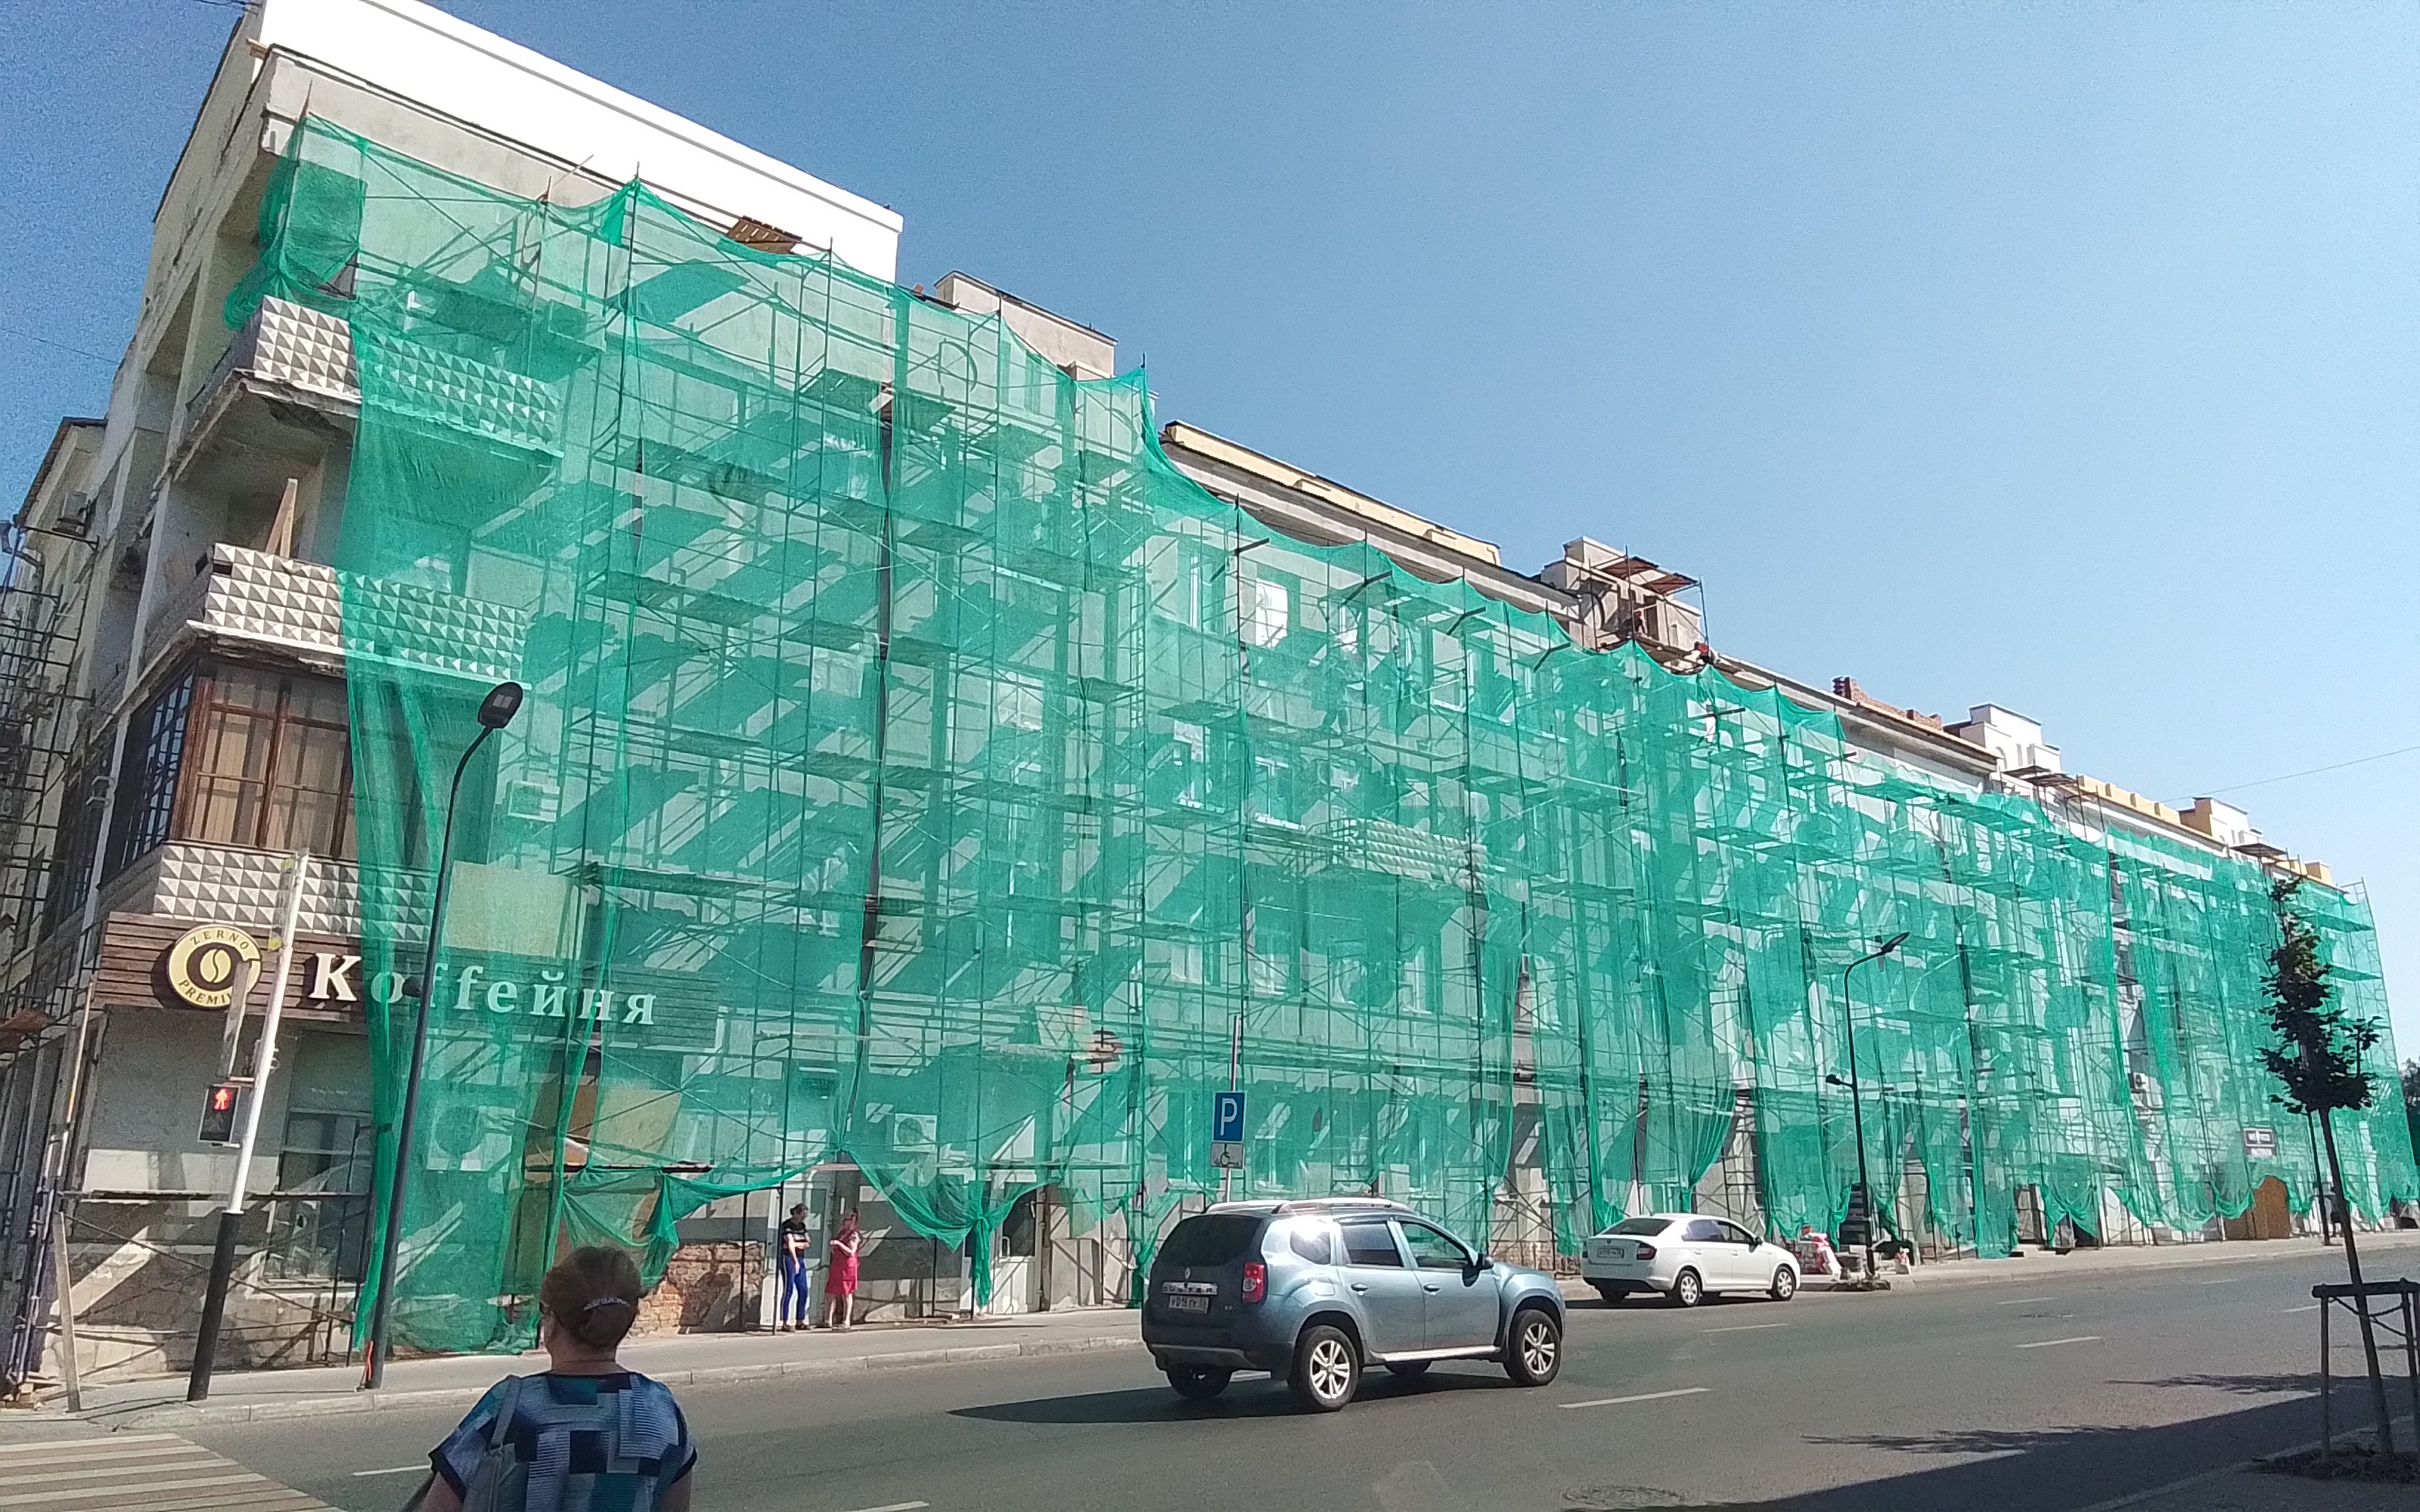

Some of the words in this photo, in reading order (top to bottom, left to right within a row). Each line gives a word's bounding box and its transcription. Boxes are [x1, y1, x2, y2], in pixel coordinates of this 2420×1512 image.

[190, 929, 250, 950] ZERNO
[178, 979, 233, 1005] PREMI
[1220, 1097, 1238, 1137] P
